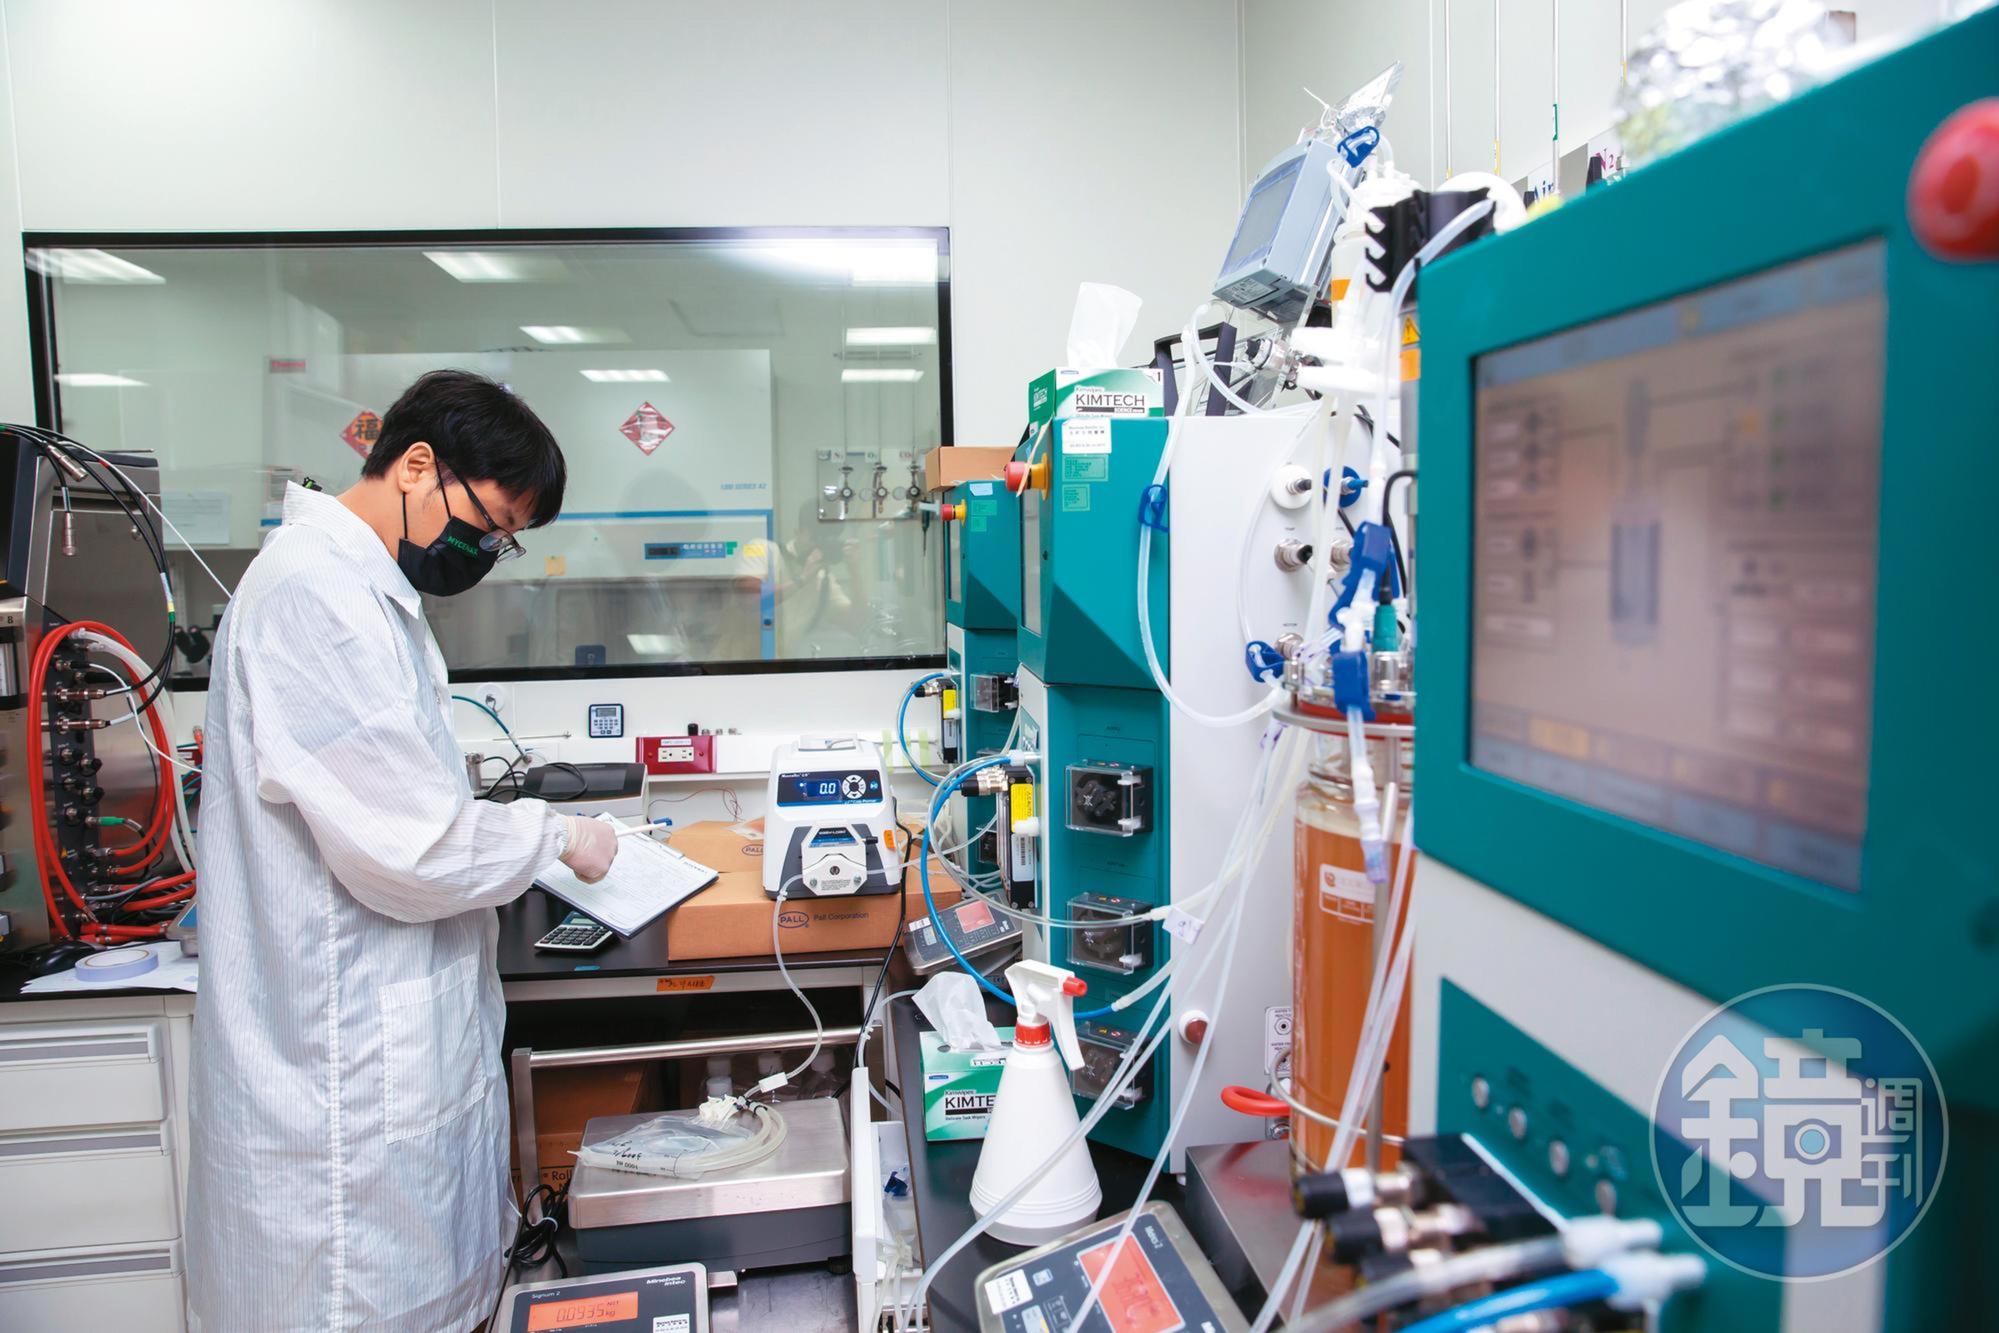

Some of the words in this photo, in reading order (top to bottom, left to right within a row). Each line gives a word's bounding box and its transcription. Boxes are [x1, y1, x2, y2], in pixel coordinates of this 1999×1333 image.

[1075, 394, 1145, 406] KIMTECH
[780, 915, 805, 923] PALL
[813, 913, 828, 921] Pall
[829, 912, 869, 922] Corporation
